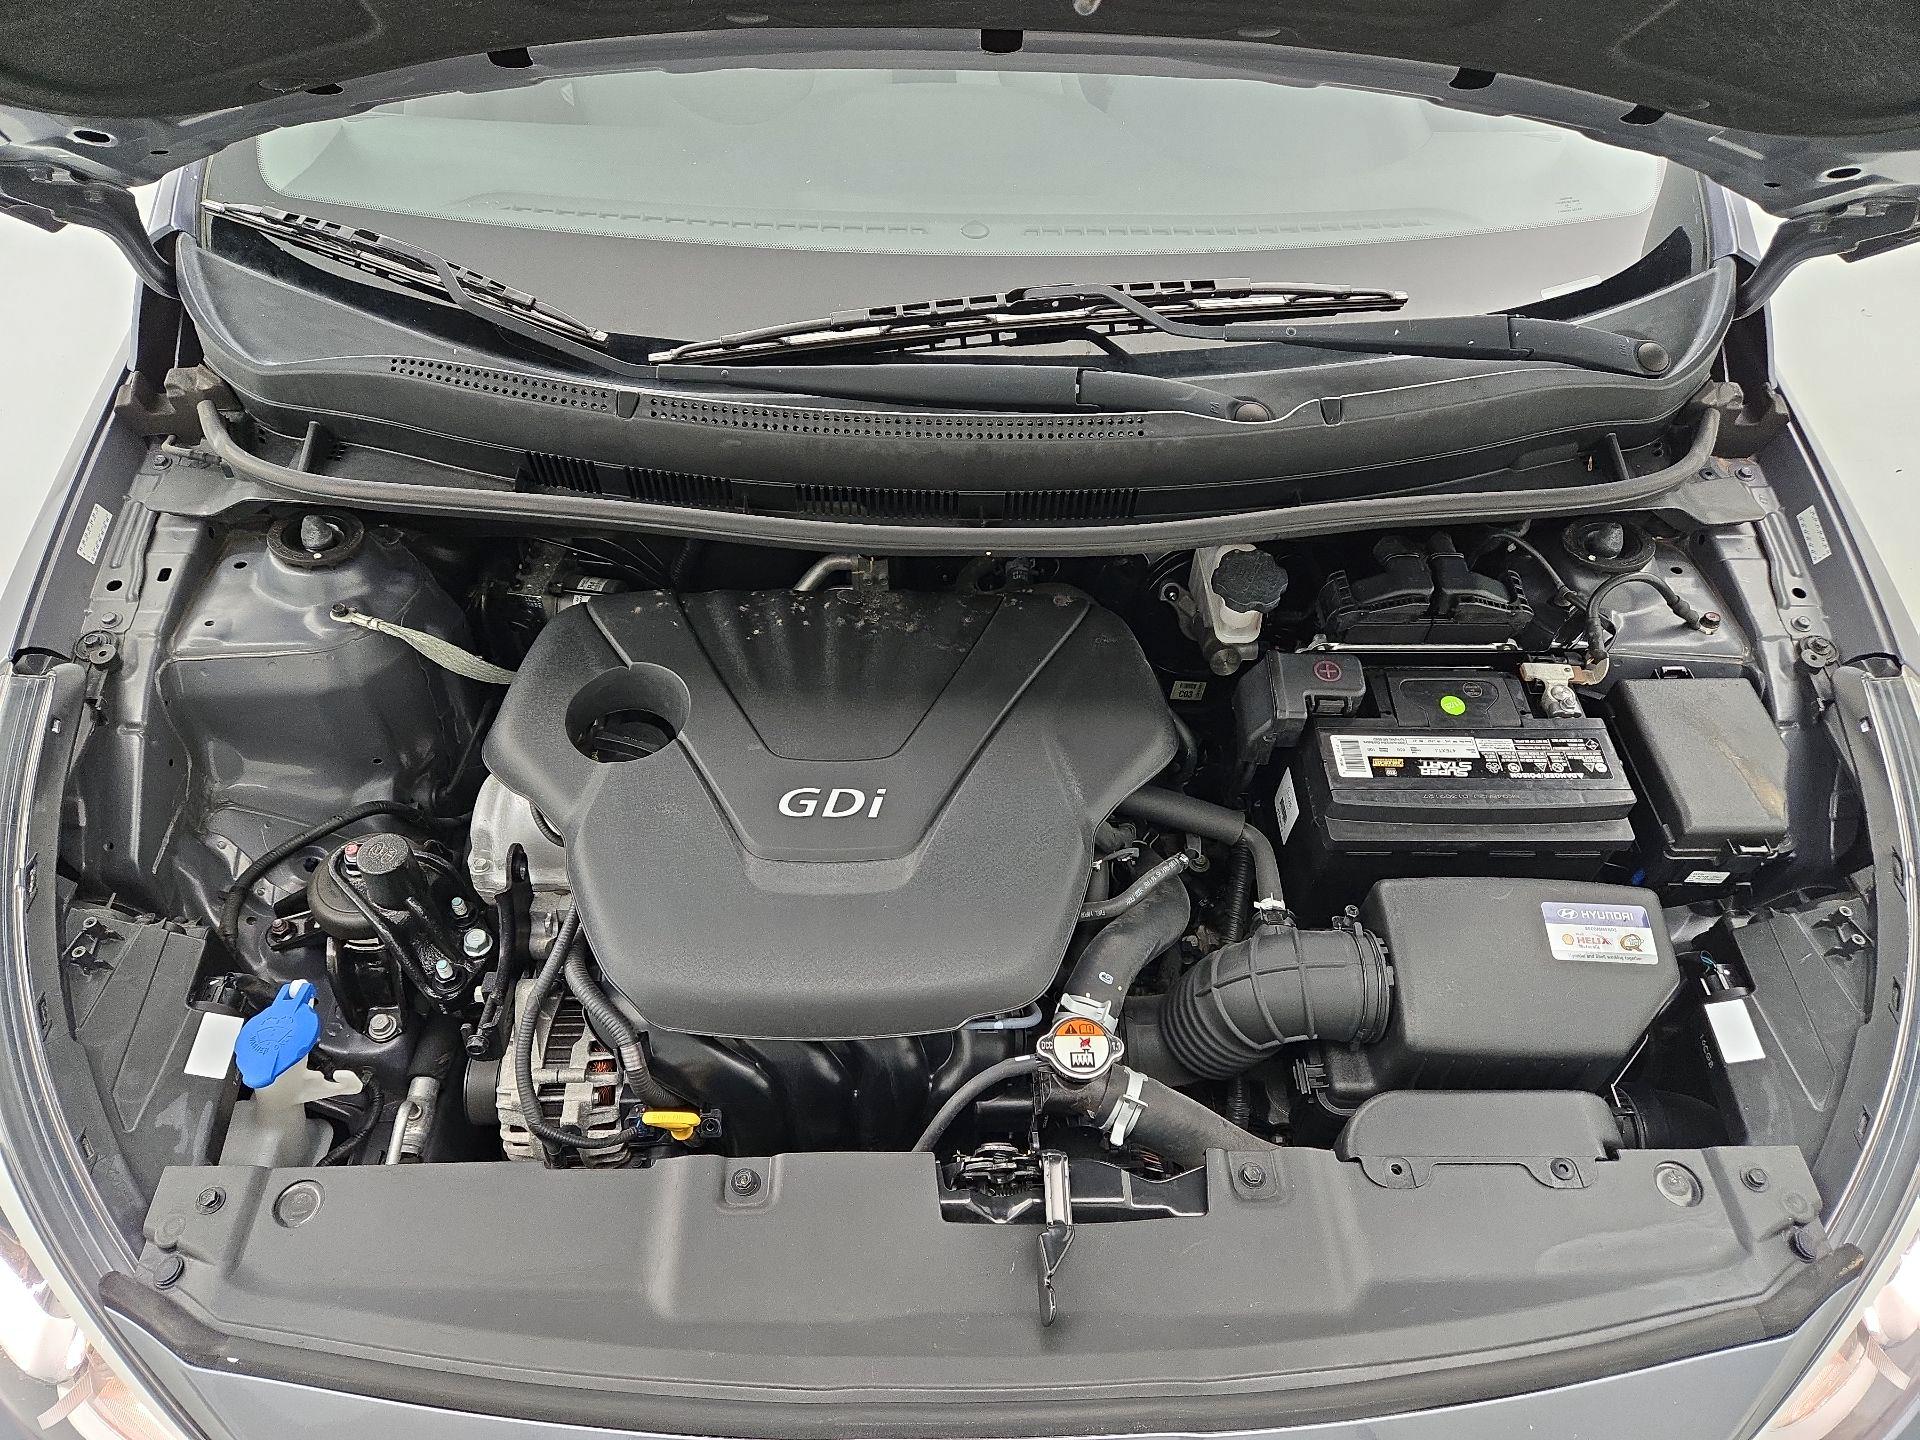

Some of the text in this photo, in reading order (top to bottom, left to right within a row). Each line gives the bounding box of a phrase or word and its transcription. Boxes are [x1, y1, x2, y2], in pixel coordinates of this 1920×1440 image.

[1416, 761, 1473, 771] START
[1420, 768, 1469, 777] SUPER
[778, 787, 887, 818] GDi
[1580, 910, 1634, 921] HYUNDAI
[1576, 936, 1613, 946] HELIX
